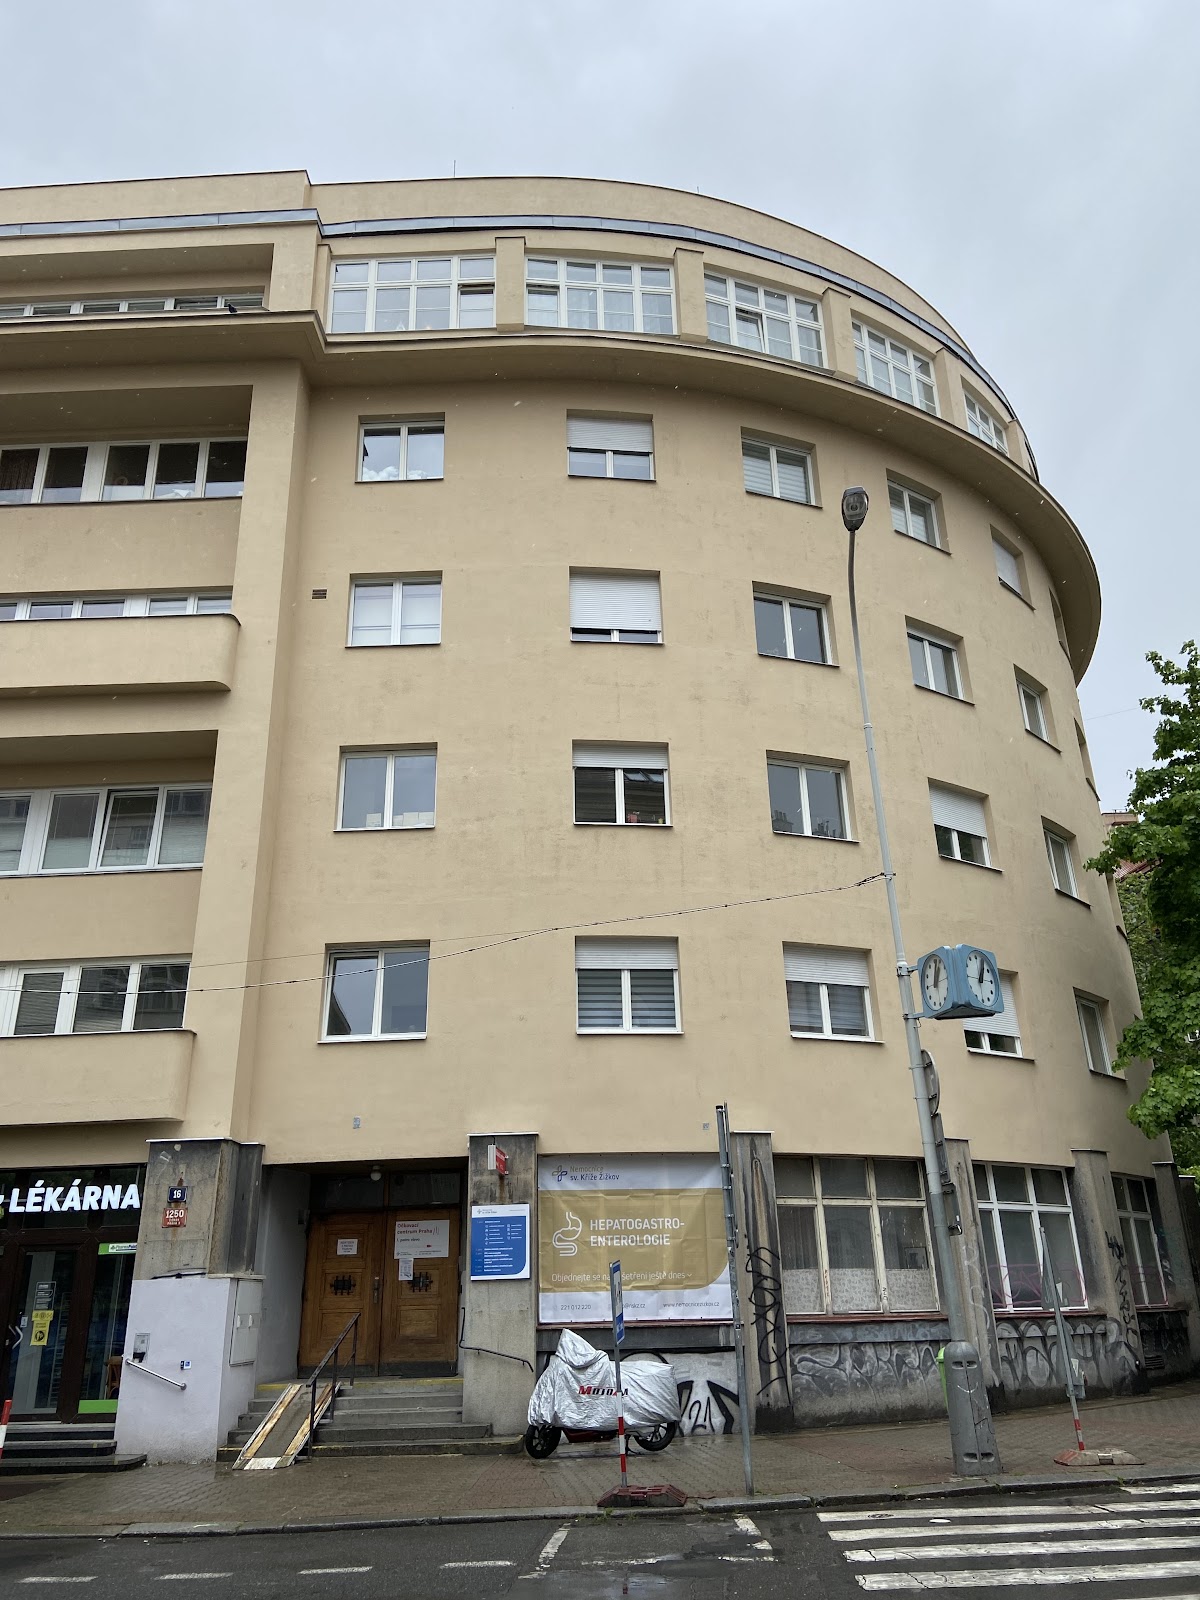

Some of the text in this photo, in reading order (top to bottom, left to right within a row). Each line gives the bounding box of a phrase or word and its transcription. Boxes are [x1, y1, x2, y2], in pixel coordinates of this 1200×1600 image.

[570, 1165, 604, 1173] Nemocnice
[581, 1173, 597, 1181] Kříže
[599, 1172, 620, 1181] Žižkov
[8, 1179, 141, 1213] LÉKÁRNA
[173, 1189, 182, 1199] 16
[165, 1209, 185, 1219] 1250
[590, 1218, 685, 1231] HEPATOGASTRO-
[590, 1234, 671, 1247] ENTEROLOGIE
[551, 1273, 591, 1282] Objednejte
[648, 1270, 667, 1281] ještě
[668, 1271, 686, 1280] dnes
